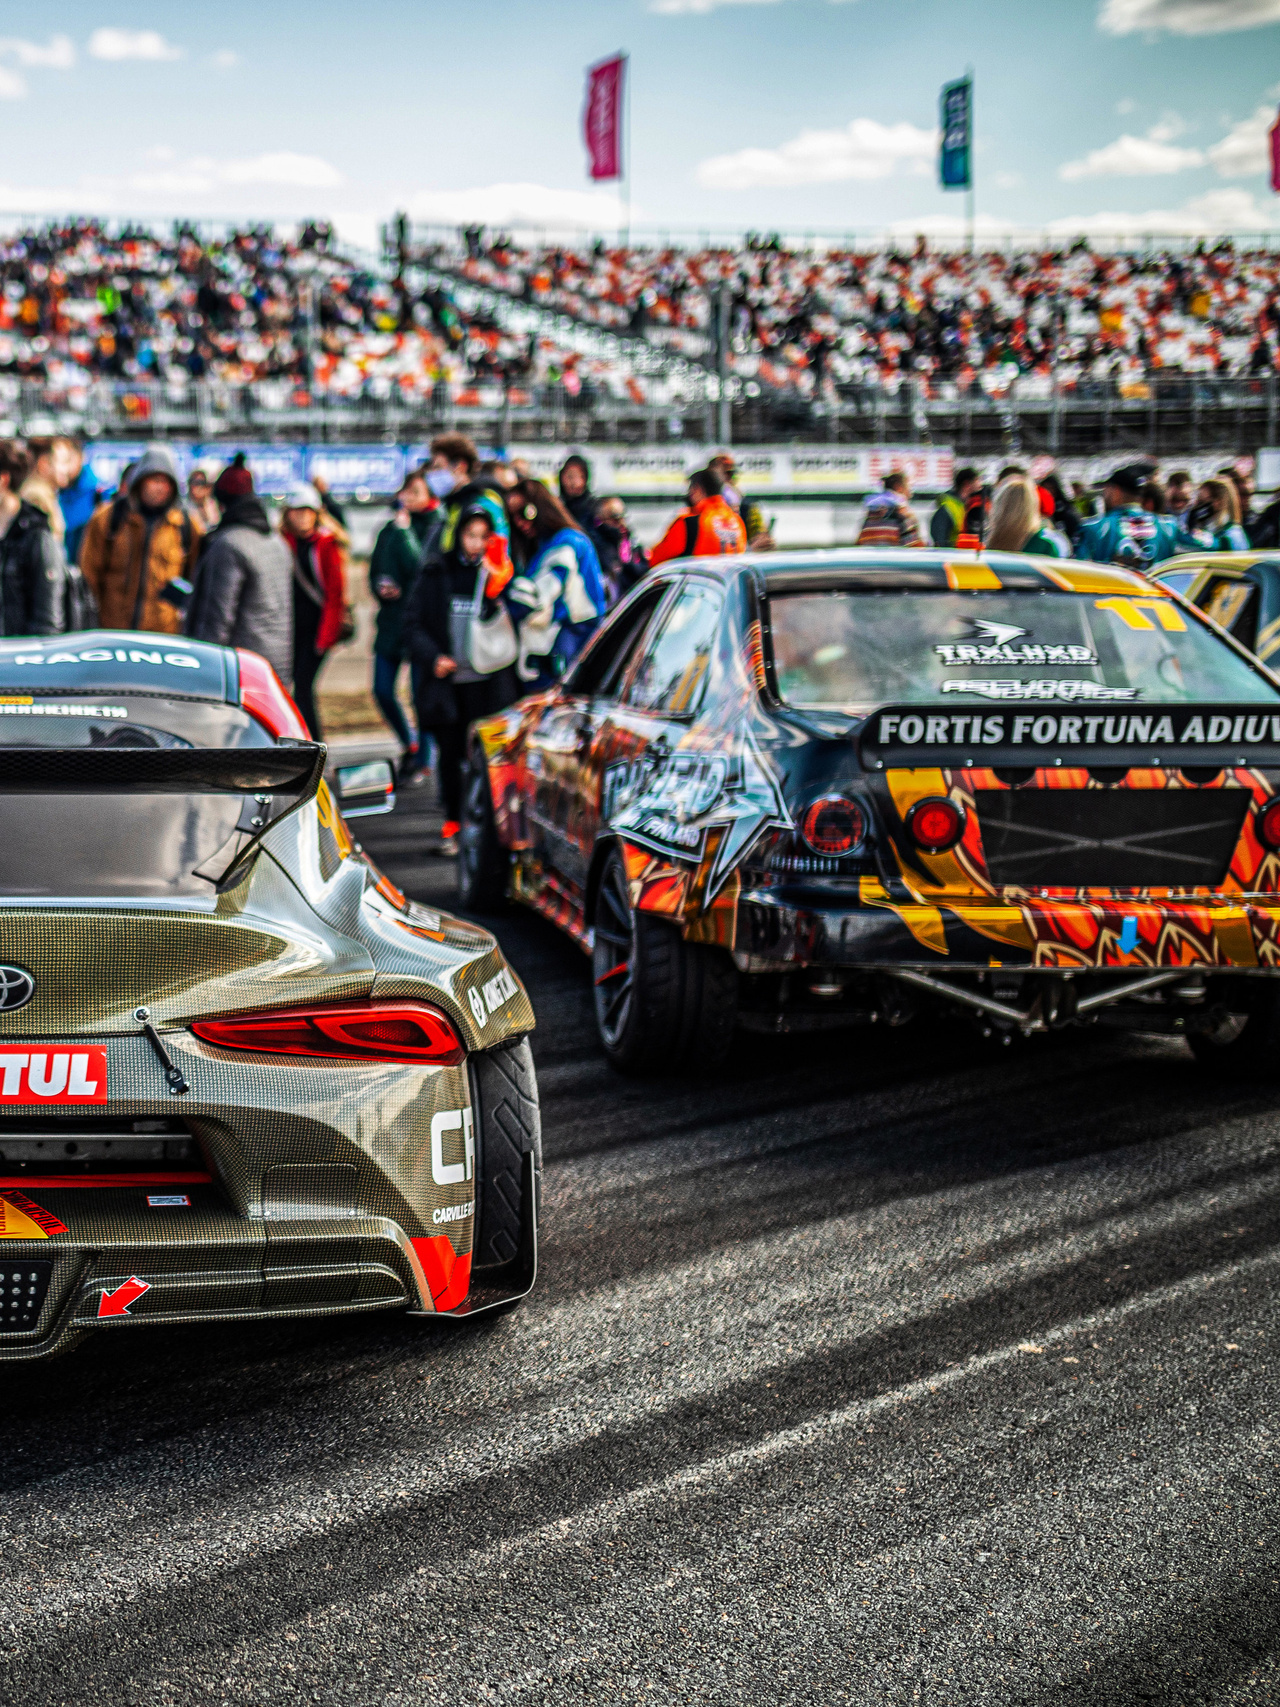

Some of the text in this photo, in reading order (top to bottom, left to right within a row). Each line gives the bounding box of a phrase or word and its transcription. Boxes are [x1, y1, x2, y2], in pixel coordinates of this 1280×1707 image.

[14, 649, 201, 669] RACING
[879, 714, 1005, 744] FORTIS
[1011, 714, 1175, 744] FORTUNA
[432, 1202, 469, 1225] CARVILLE
